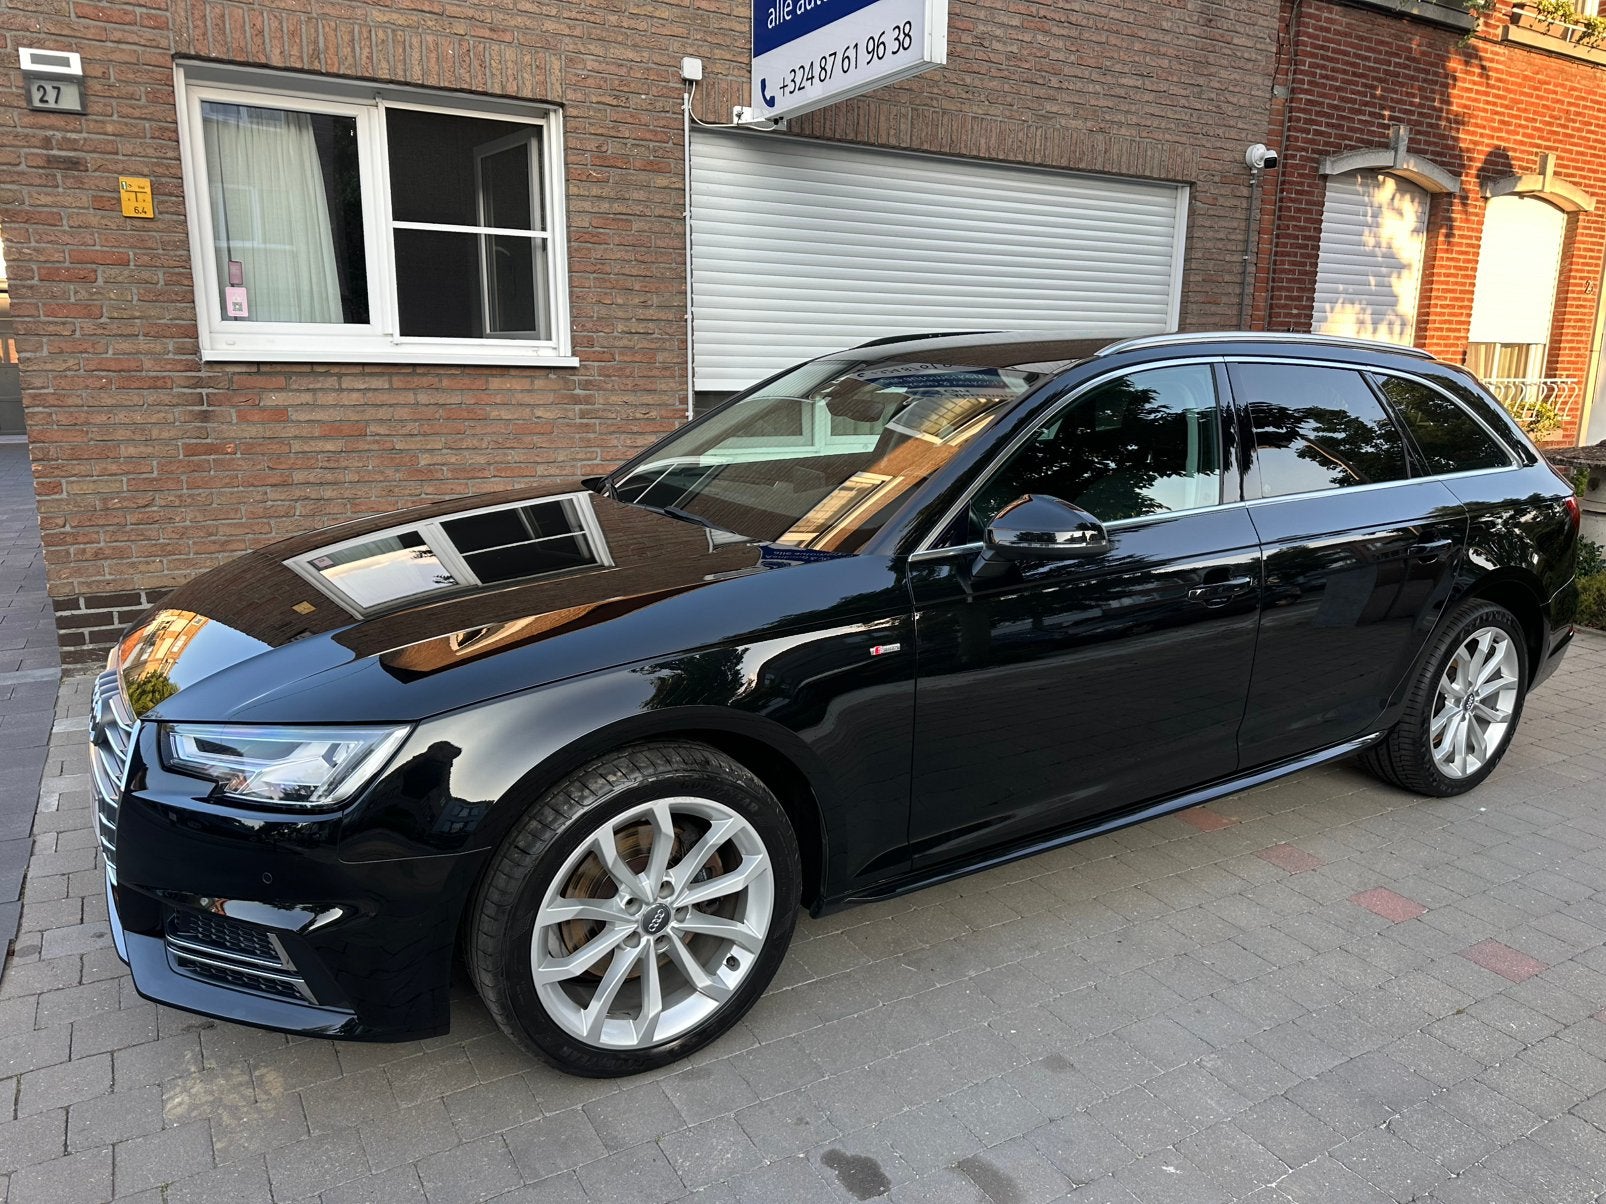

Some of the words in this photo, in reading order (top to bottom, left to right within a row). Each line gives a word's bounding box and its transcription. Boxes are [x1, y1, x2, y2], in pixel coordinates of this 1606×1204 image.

[779, 60, 815, 98] +324
[818, 52, 838, 83] 87
[841, 42, 859, 74] 61
[866, 30, 886, 66] 96
[892, 20, 912, 55] 38
[36, 84, 62, 105] 27
[134, 206, 147, 214] 6.4
